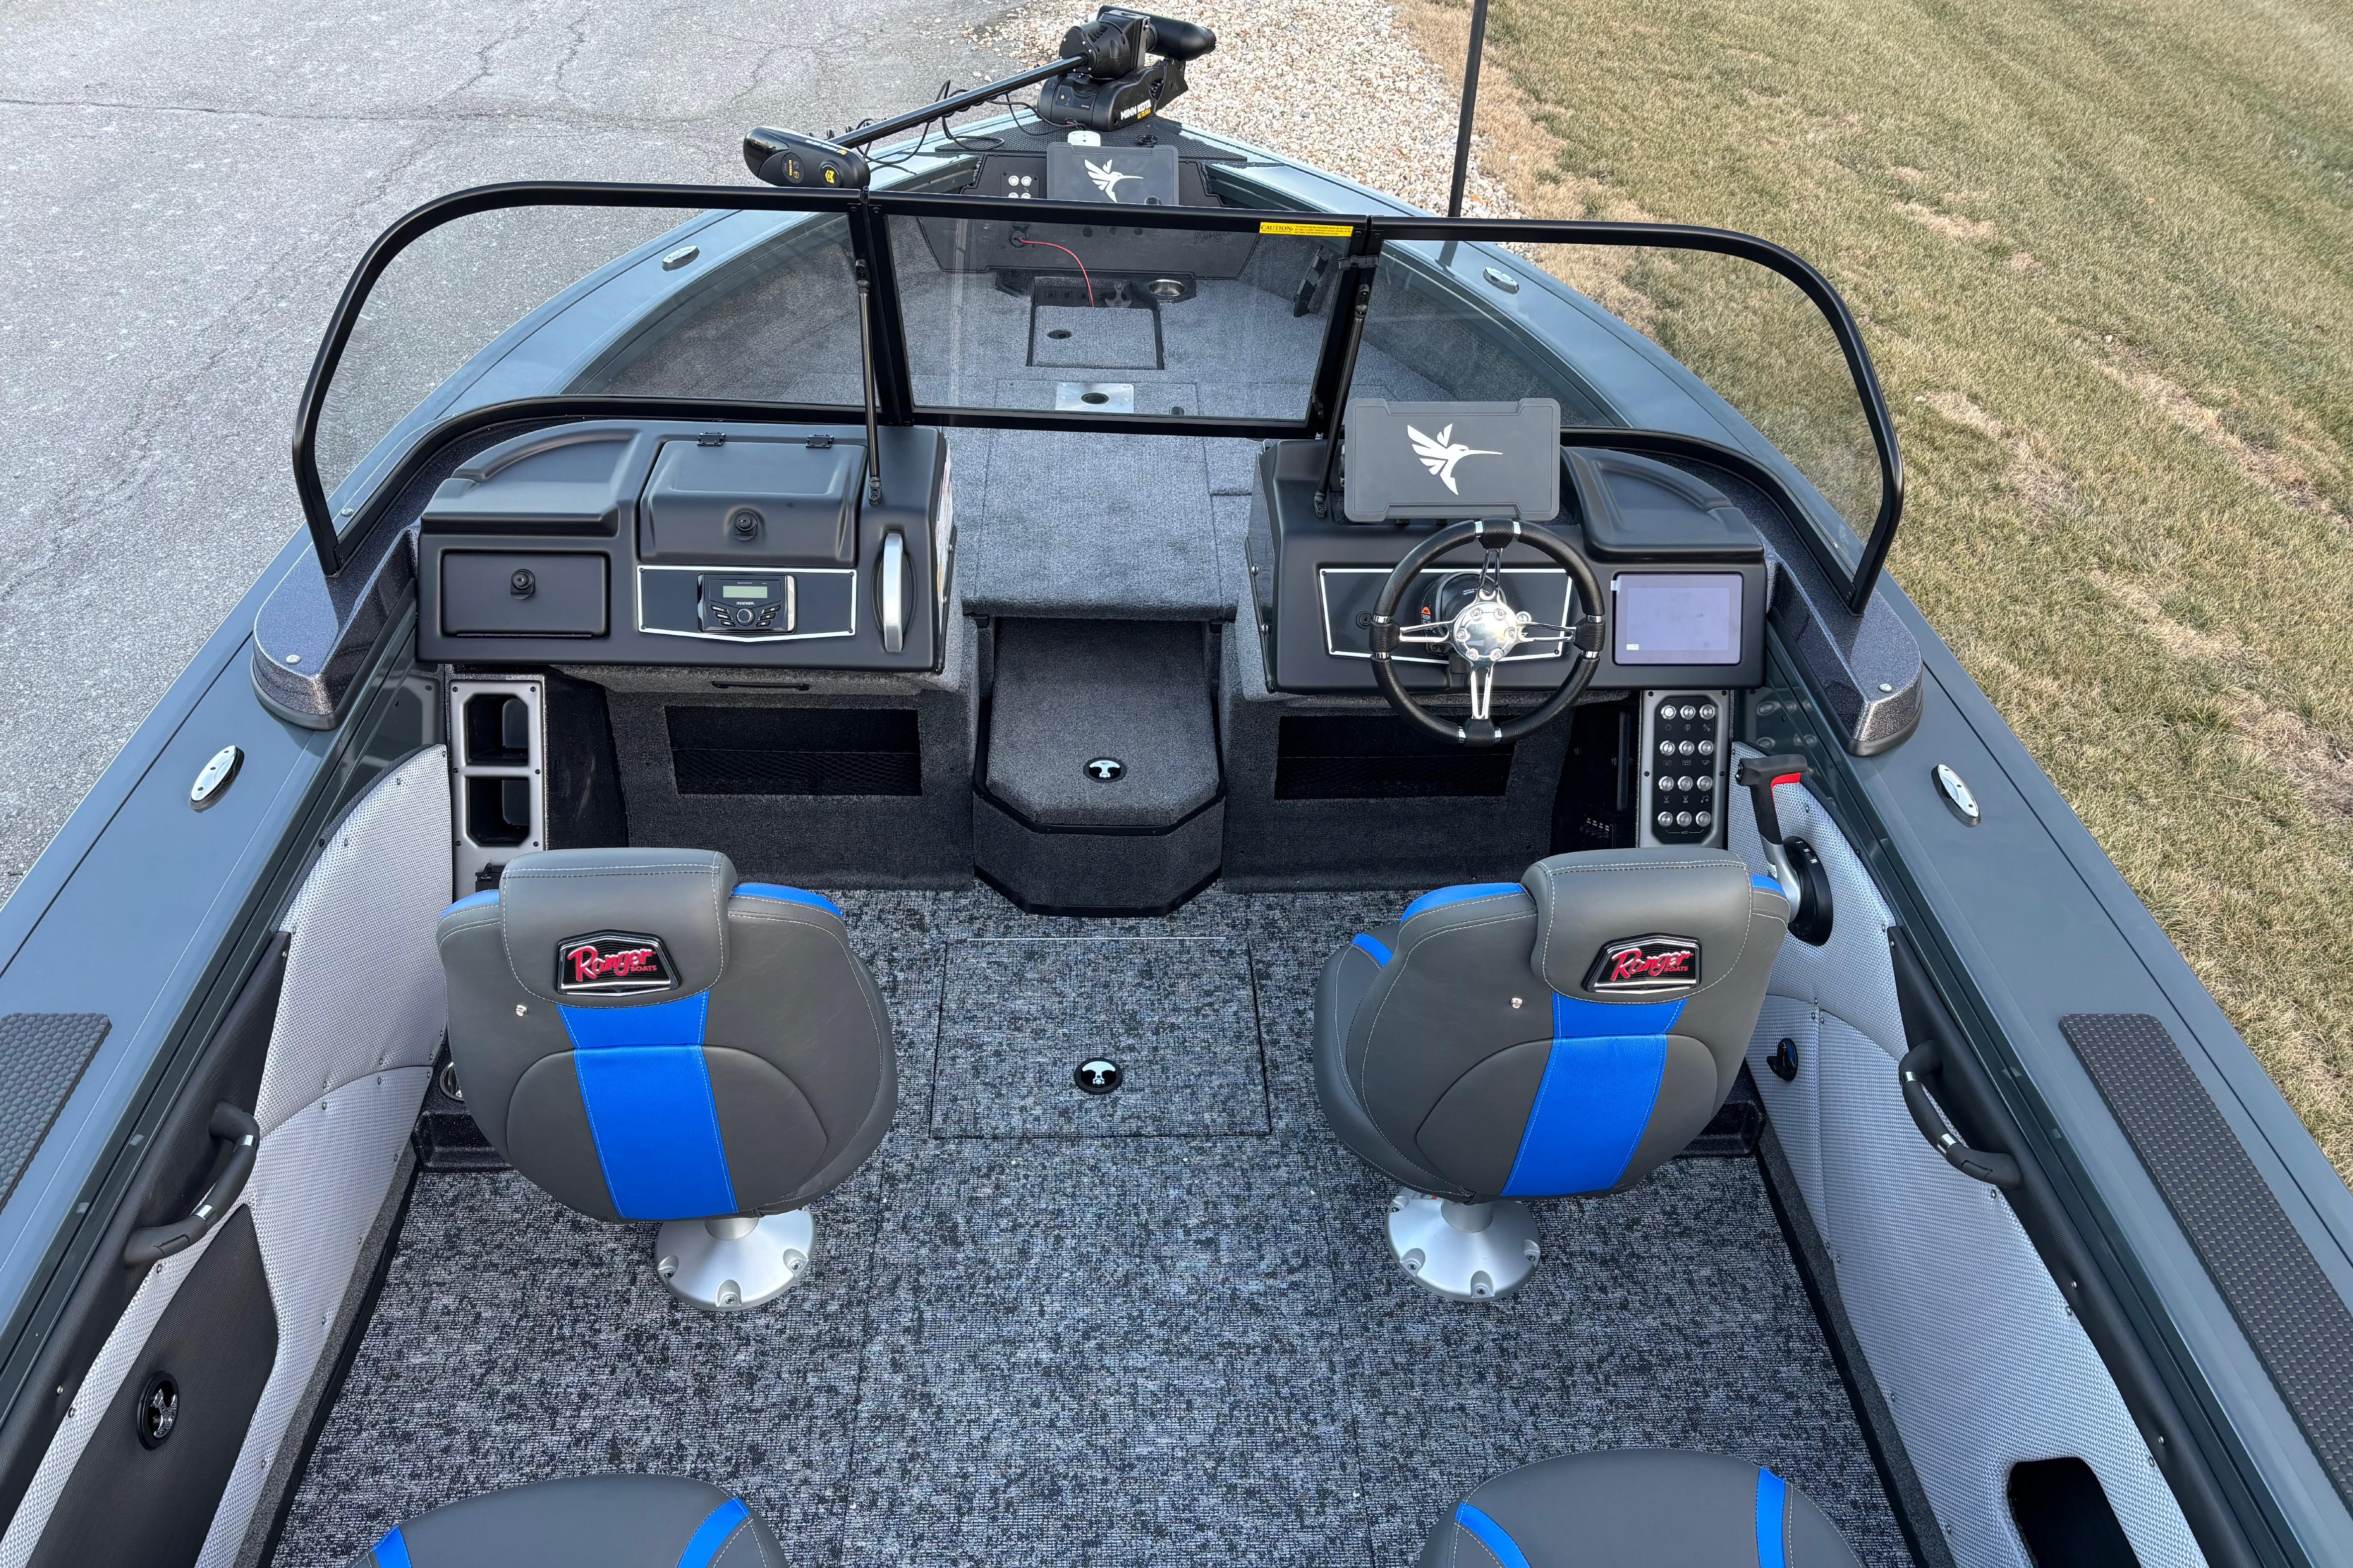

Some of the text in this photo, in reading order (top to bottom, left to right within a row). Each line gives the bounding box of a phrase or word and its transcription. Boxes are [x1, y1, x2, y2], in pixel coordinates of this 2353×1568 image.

[1121, 99, 1151, 120] MINN KOTA
[567, 945, 652, 981] Ranger
[1610, 948, 1691, 981] Ranger
